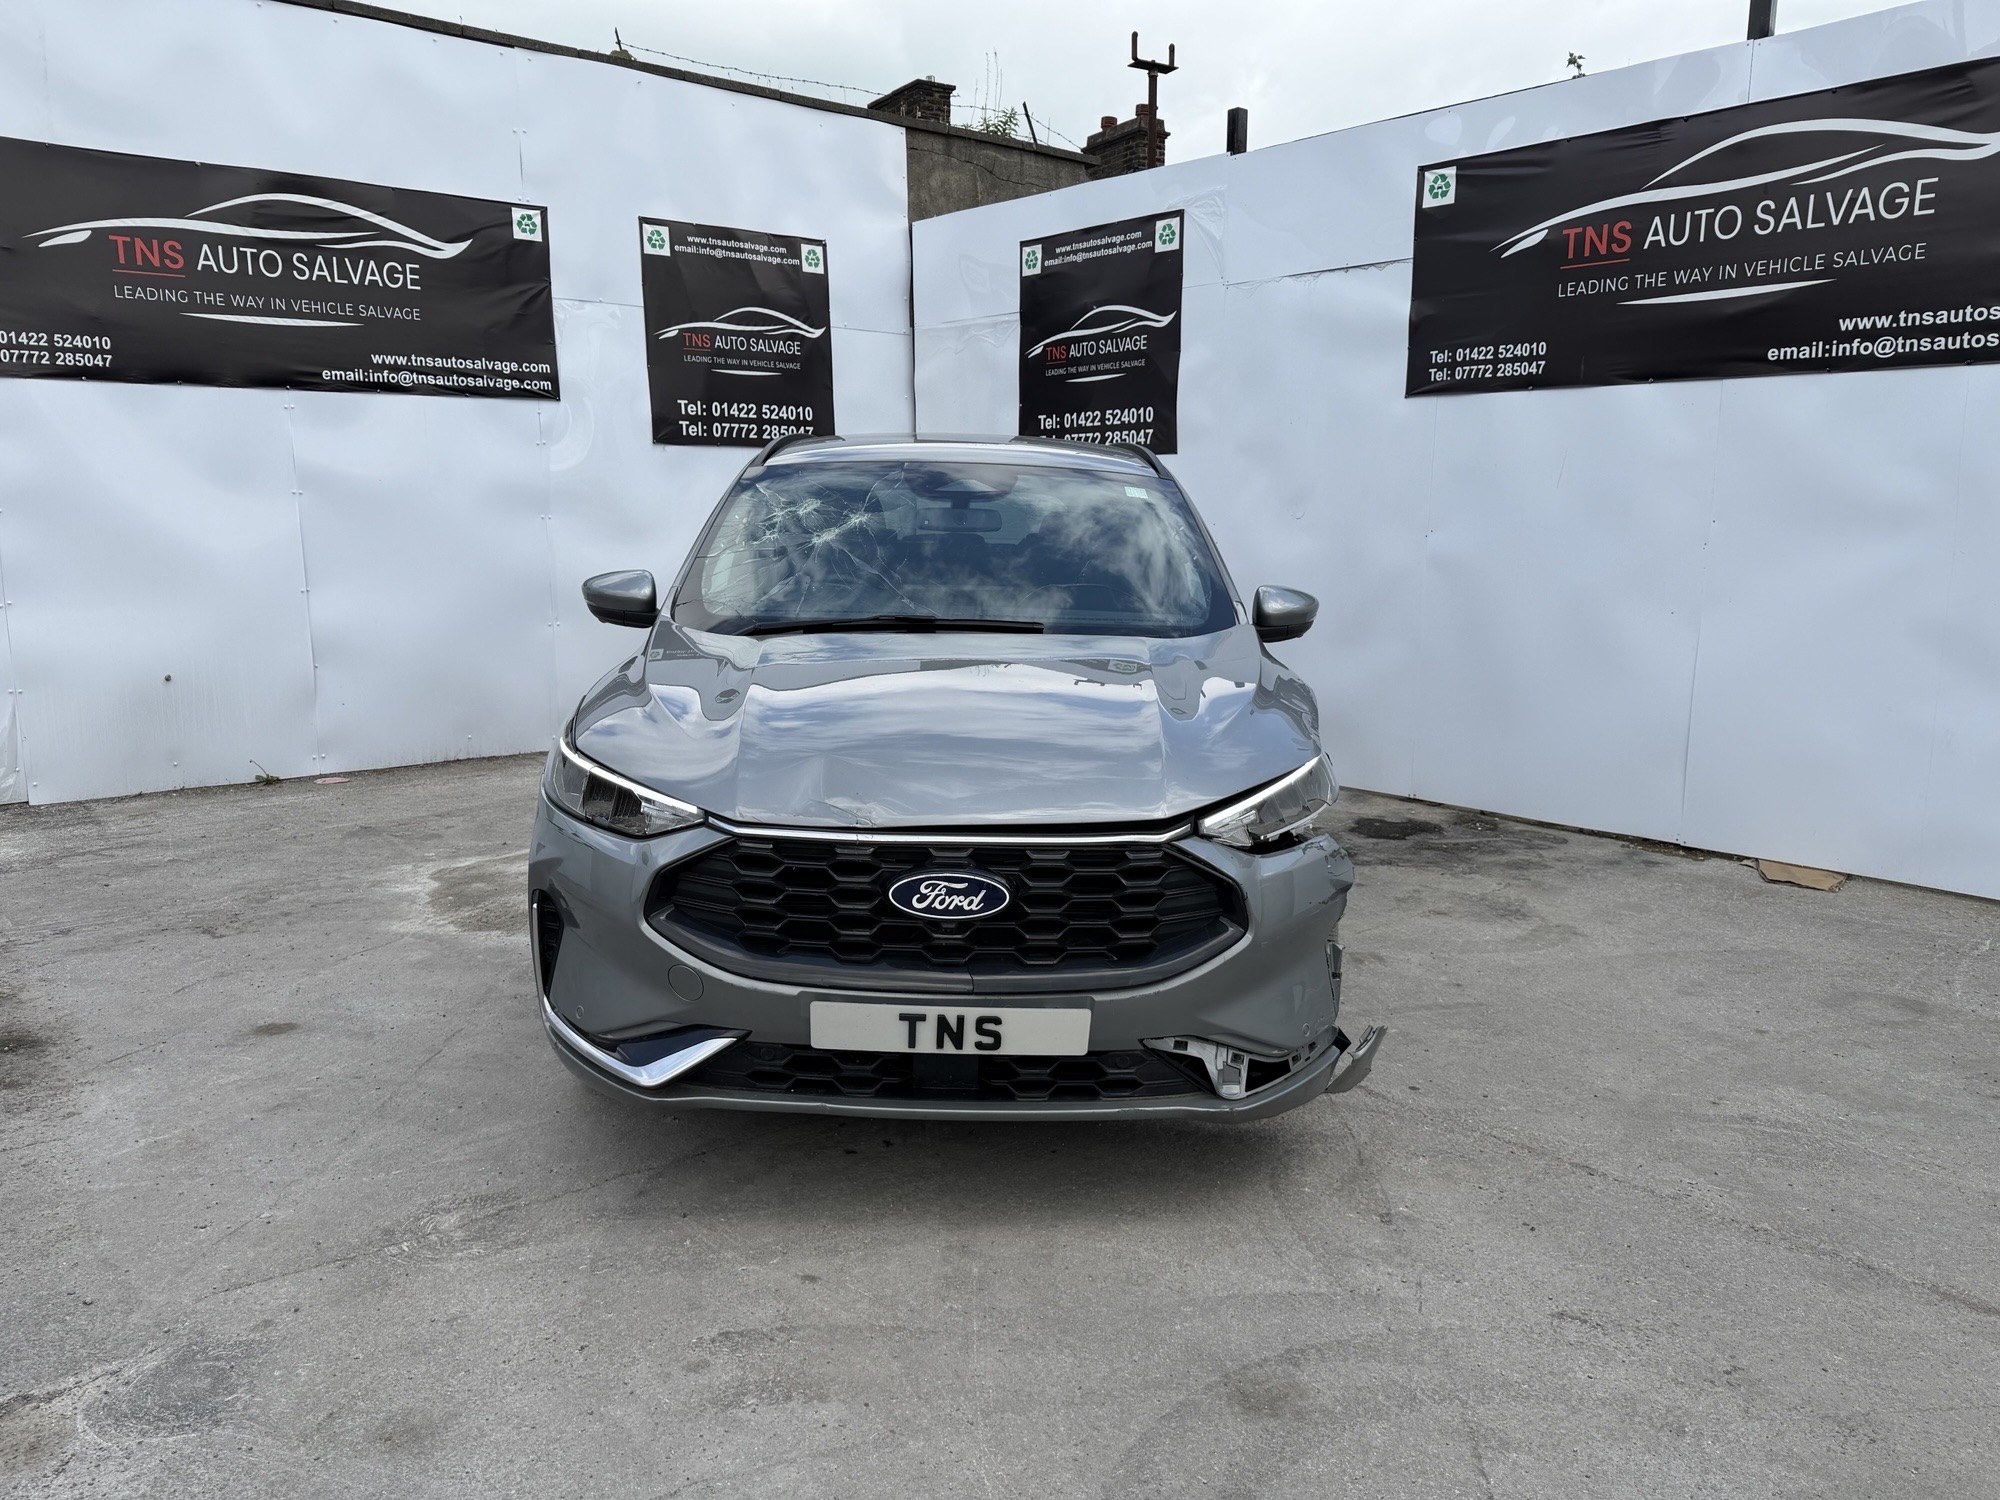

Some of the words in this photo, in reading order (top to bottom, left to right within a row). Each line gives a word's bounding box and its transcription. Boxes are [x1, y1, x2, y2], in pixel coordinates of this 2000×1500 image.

[1561, 220, 1633, 260] TNS
[1643, 204, 1743, 250] AUTO
[1753, 177, 1939, 236] SALVAGE
[687, 234, 787, 254] www.tnsautosalvage.com
[1044, 240, 1153, 267] email:info@tnsautosalvage.com
[1055, 230, 1142, 254] www.tnsautosalvage.com
[108, 234, 186, 269] TNS
[196, 243, 283, 278] AUTO
[292, 251, 422, 290] SALVAGE
[674, 244, 800, 266] email:info@tnsautosalvage.com
[1557, 276, 1629, 298] LEADING
[1635, 271, 1667, 289] THE
[1673, 266, 1714, 285] WAY
[1718, 263, 1737, 279] IN
[1744, 253, 1825, 277] VEHICLE
[1832, 242, 1927, 269] SALVAGE
[113, 284, 189, 304] LEADING
[193, 291, 226, 307] THE
[229, 294, 265, 309] WAY
[270, 297, 286, 311] IN
[290, 299, 354, 317] VEHICLE
[358, 304, 421, 321] SALVAGE
[0, 330, 49, 346] 01422
[53, 333, 111, 350] 524010
[683, 332, 711, 349] TNS
[714, 334, 747, 351] AUTO
[749, 337, 801, 355] SALVAGE
[1045, 345, 1067, 361] TNS
[1068, 341, 1097, 358] AUTO
[1098, 334, 1148, 355] SALVAGE
[0, 349, 51, 365] 07772
[55, 352, 113, 368] 285047
[370, 353, 551, 374] www.tnsautosalvage.com
[683, 354, 712, 364] LEADING
[713, 356, 726, 365] THE
[726, 358, 740, 366] WAY
[749, 359, 775, 368] VEHICLE
[776, 361, 801, 370] SALVAGE
[1429, 349, 1453, 364] Tel:
[1456, 345, 1495, 362] 01422
[1498, 341, 1547, 359] 524010
[1045, 367, 1067, 377] LEADING
[1067, 366, 1077, 374] THE
[1077, 364, 1090, 373] WAY
[1089, 363, 1097, 371] IN
[1097, 361, 1120, 371] VEHICLE
[1120, 358, 1146, 369] SALVAGE
[1428, 367, 1451, 382] Tel:
[1454, 364, 1493, 380] 07772
[1496, 360, 1546, 377] 285047
[322, 368, 552, 391] email:info@tnsautosalvage.com
[677, 399, 707, 416] Tel:
[712, 401, 757, 419] 01422
[761, 404, 813, 421] 524010
[1038, 414, 1060, 429] Tel:
[1064, 410, 1101, 428] 01422
[1105, 406, 1154, 425] 524010
[679, 420, 707, 437] Tel:
[712, 422, 758, 439] 07772
[912, 880, 986, 911] Ford
[899, 1013, 1003, 1051] TNS
